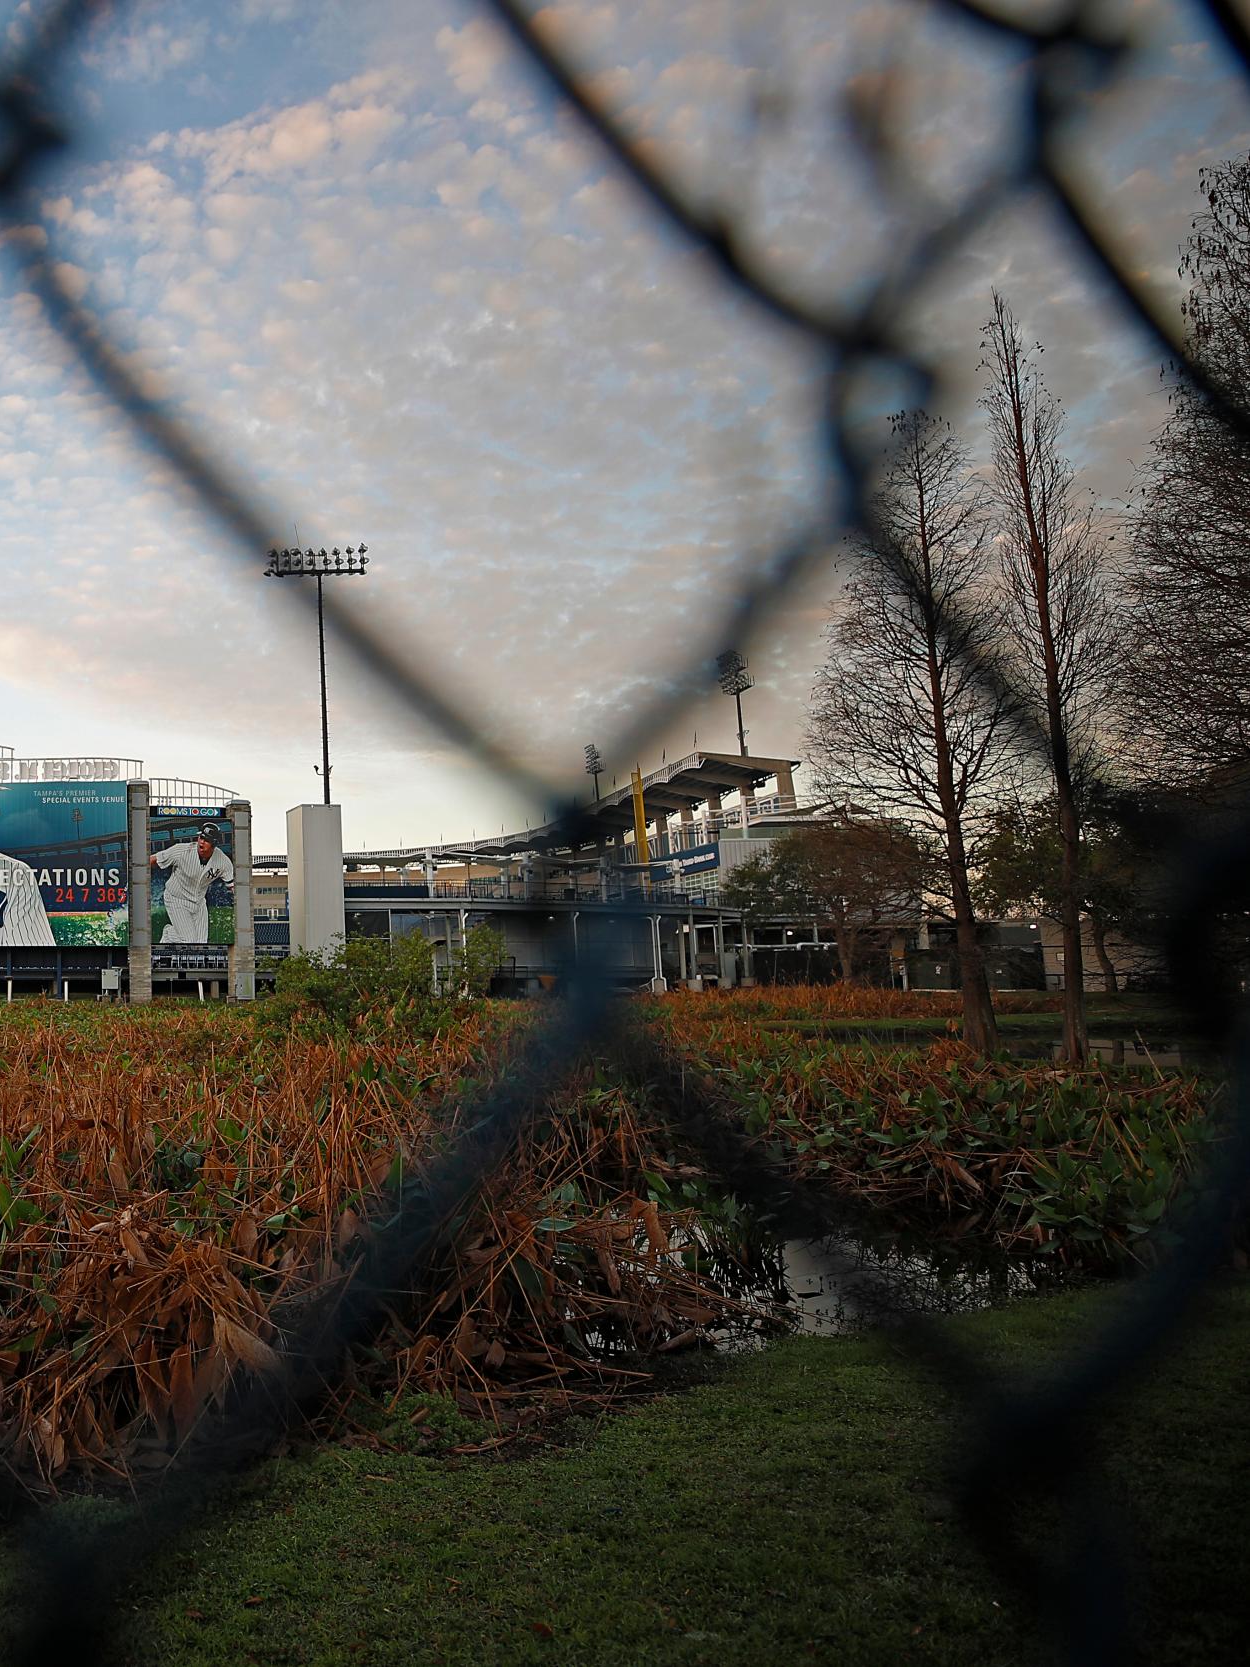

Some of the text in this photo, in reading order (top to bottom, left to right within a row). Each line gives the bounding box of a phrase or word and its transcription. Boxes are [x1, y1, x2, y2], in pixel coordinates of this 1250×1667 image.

[158, 807, 188, 815] ROOMS
[200, 808, 214, 816] GO
[55, 888, 127, 903] 24 7 365
